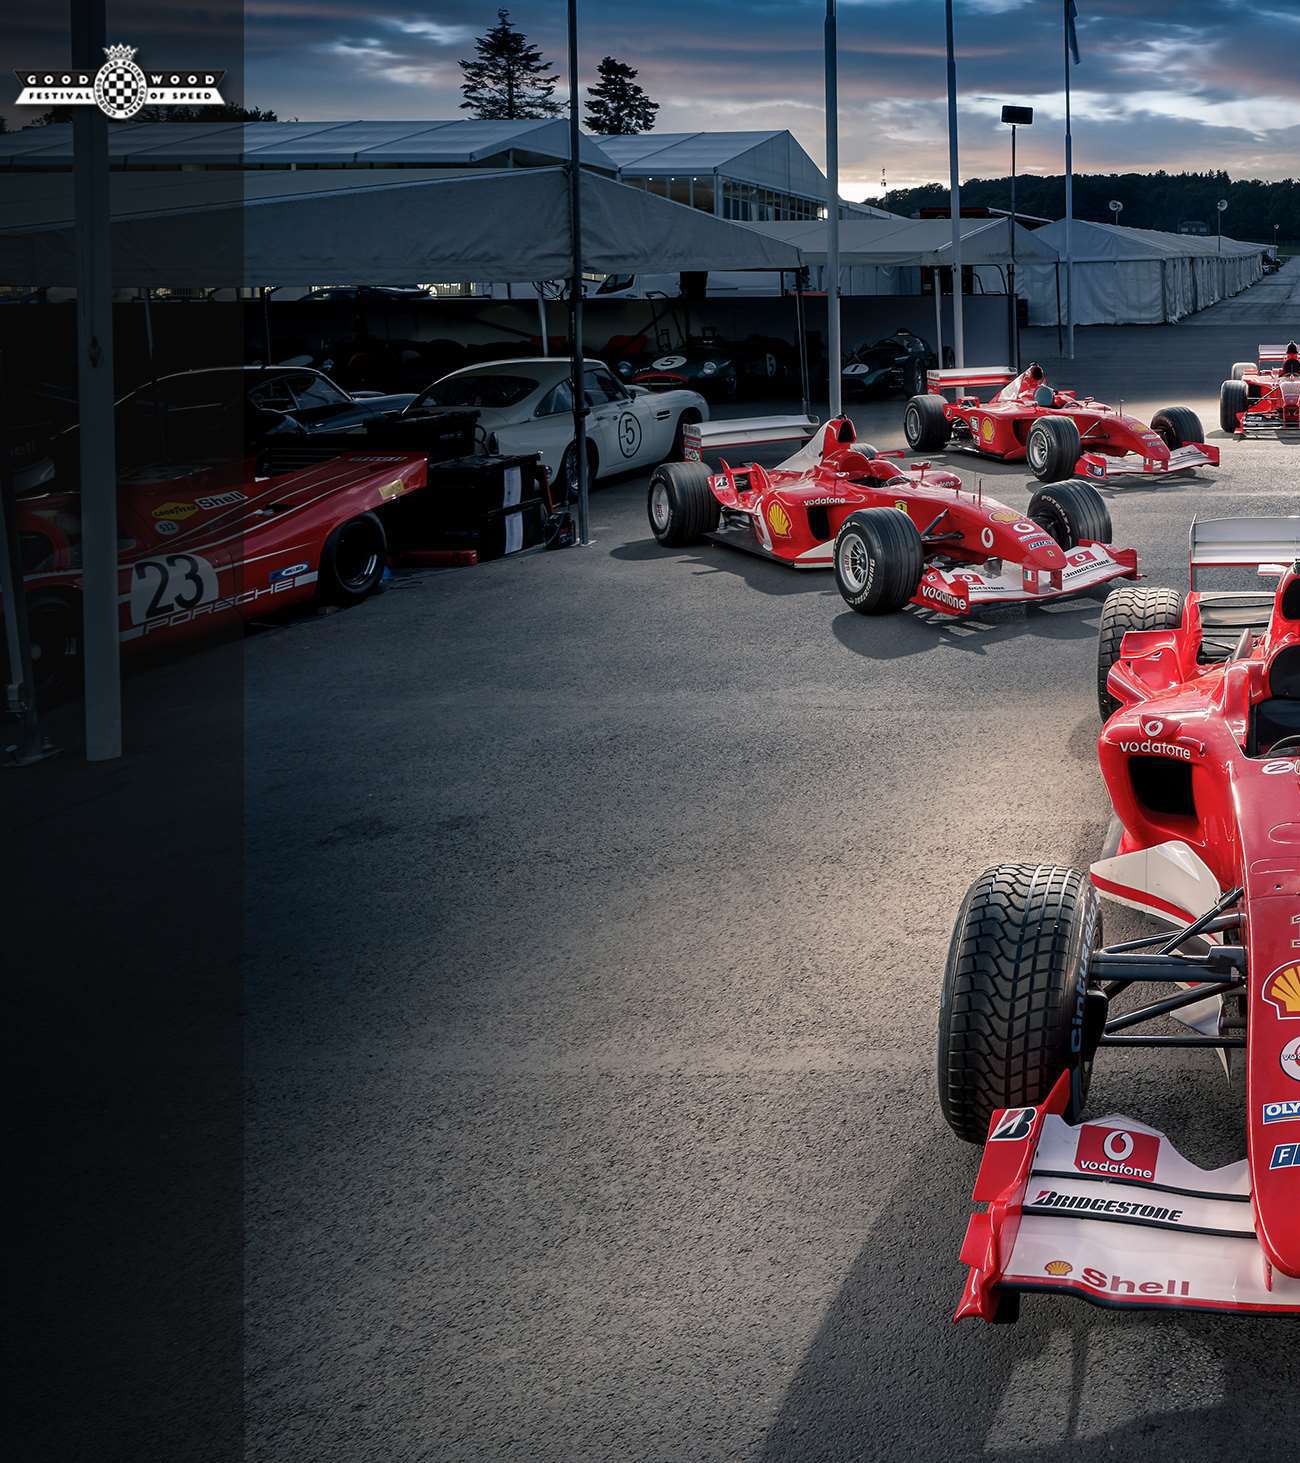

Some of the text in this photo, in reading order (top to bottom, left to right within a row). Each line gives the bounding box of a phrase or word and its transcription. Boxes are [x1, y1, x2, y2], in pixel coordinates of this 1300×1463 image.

[625, 417, 635, 445] 5
[198, 491, 245, 508] Shell
[803, 496, 846, 506] vodafone
[134, 554, 204, 619] 23
[922, 585, 967, 610] vodafone
[144, 578, 295, 635] PORSCHE
[1120, 740, 1191, 760] vodafone
[1080, 1158, 1153, 1179] vodafone
[1032, 1190, 1184, 1222] BRIDGESTONE
[1081, 1267, 1190, 1296] Shell
